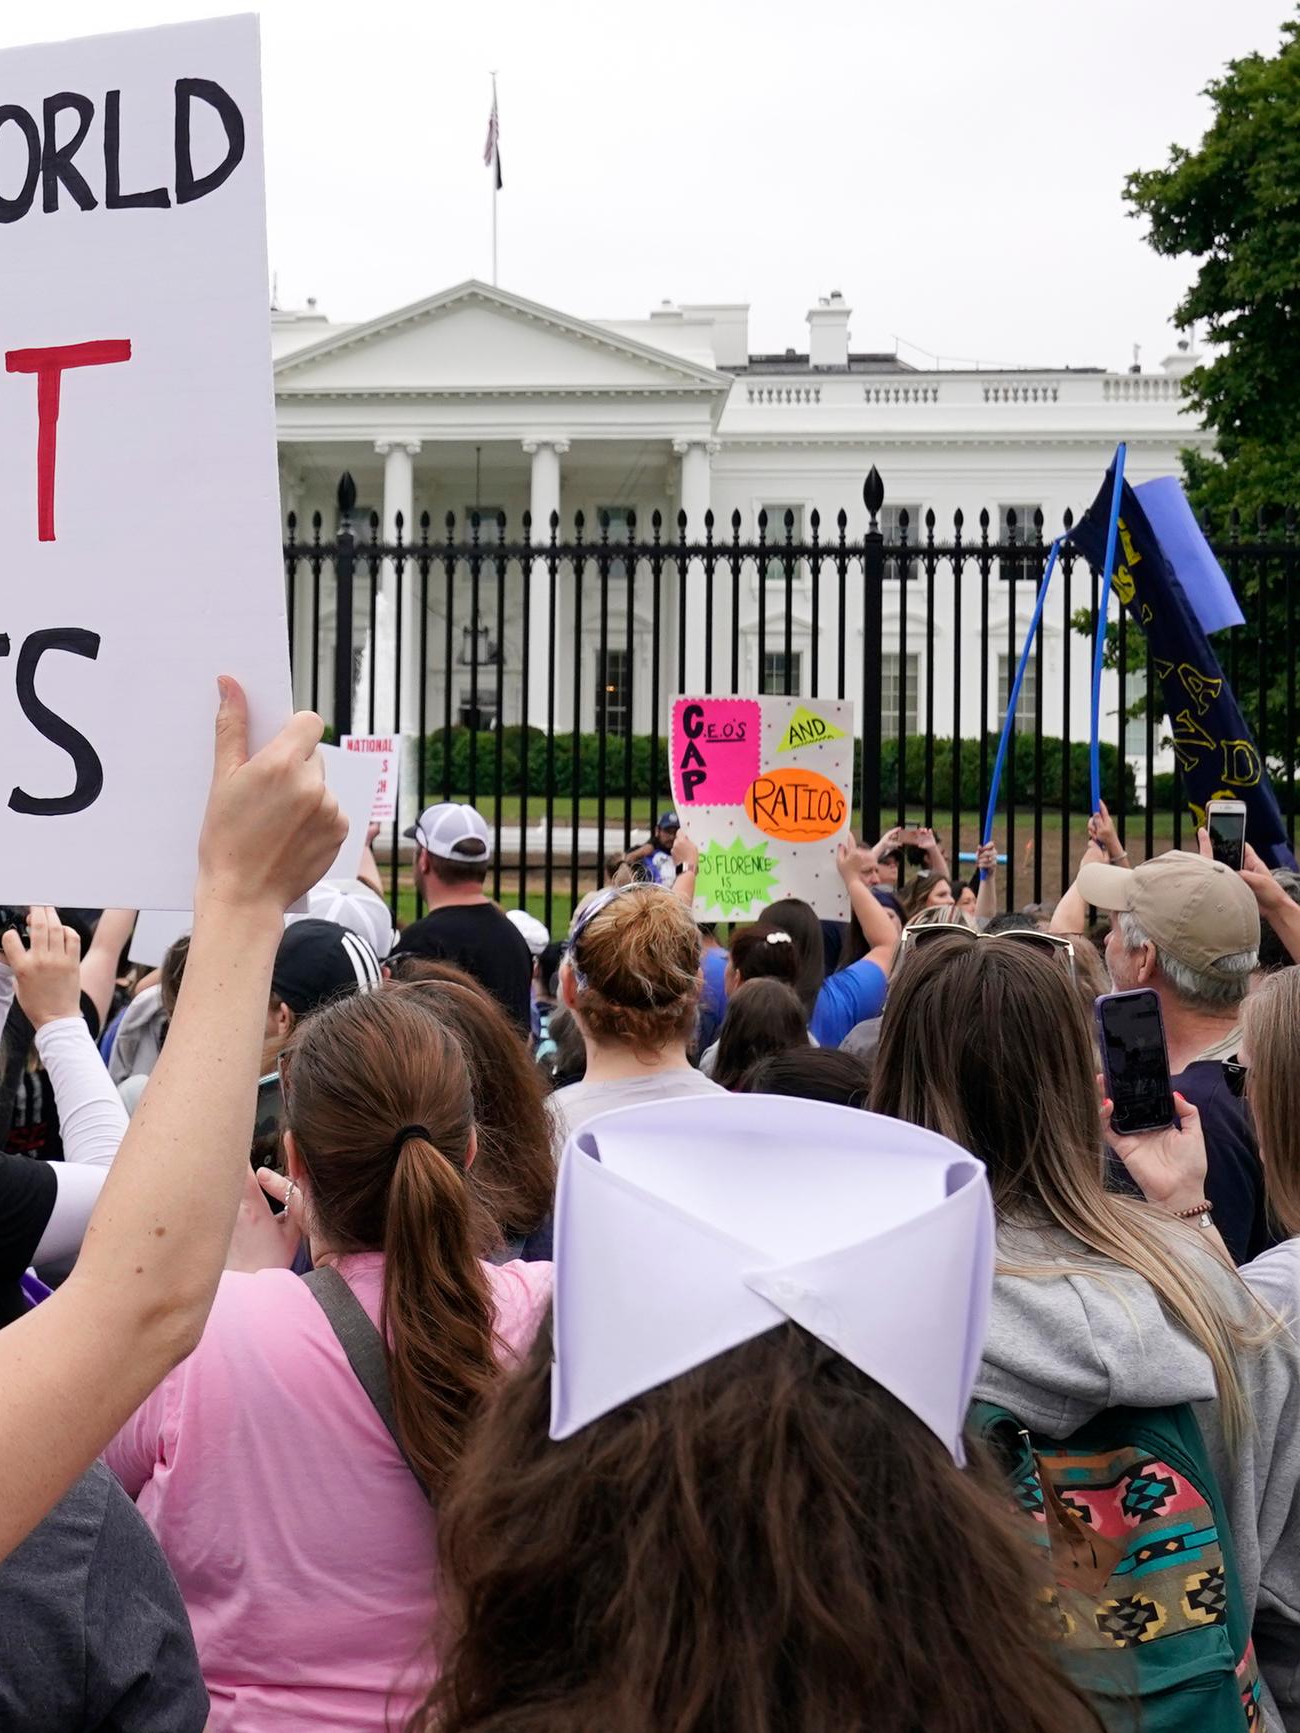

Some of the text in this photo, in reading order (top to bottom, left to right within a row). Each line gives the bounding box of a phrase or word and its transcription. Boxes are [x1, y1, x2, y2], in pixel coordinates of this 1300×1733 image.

[789, 718, 826, 744] AND
[347, 739, 393, 752] NATIONAL
[681, 704, 706, 801] CAP
[715, 855, 773, 875] FLORENCE
[721, 876, 732, 888] IS
